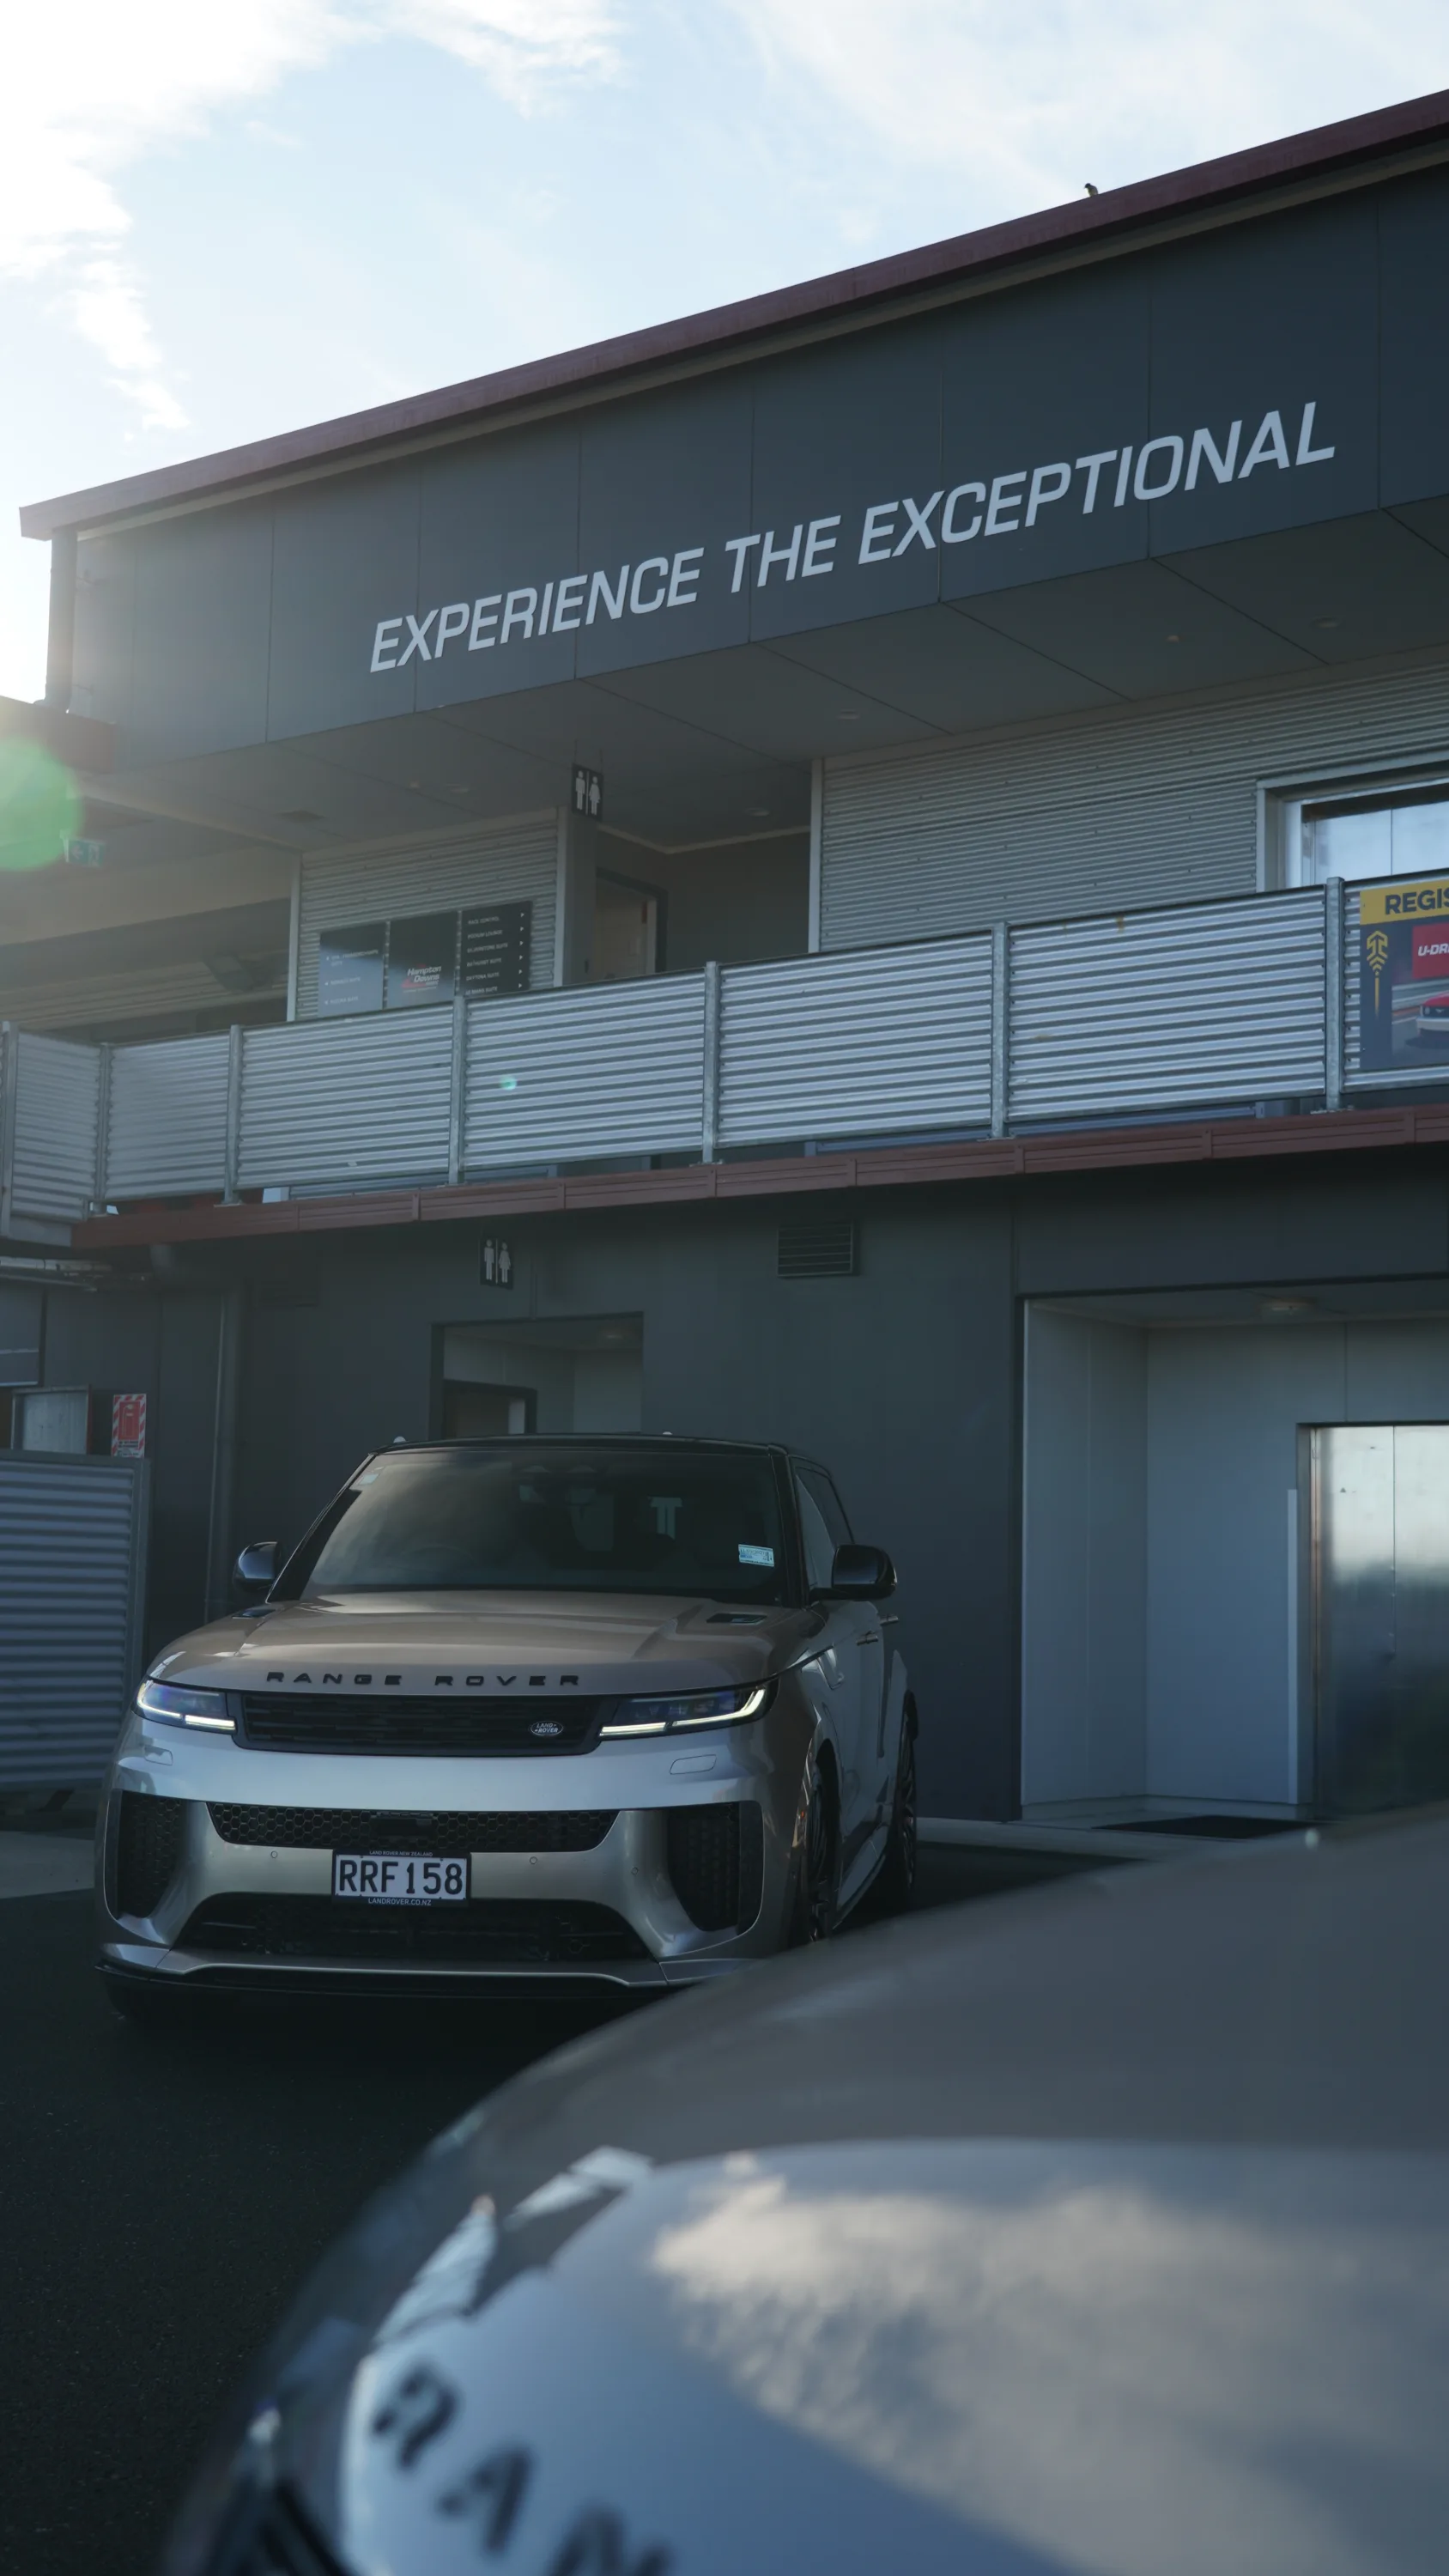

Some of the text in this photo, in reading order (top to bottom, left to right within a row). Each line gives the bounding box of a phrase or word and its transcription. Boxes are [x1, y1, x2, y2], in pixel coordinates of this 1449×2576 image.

[370, 401, 1336, 673] EXPERIENCE THE EXCEPTIONAL
[1417, 943, 1449, 957] U-DR
[407, 965, 442, 976] Hampton
[413, 974, 440, 983] Downs
[266, 1671, 579, 1686] RANGE ROVER
[339, 1860, 463, 1895] RRF158
[368, 1898, 432, 1906] LANDROVER.CO.NZ
